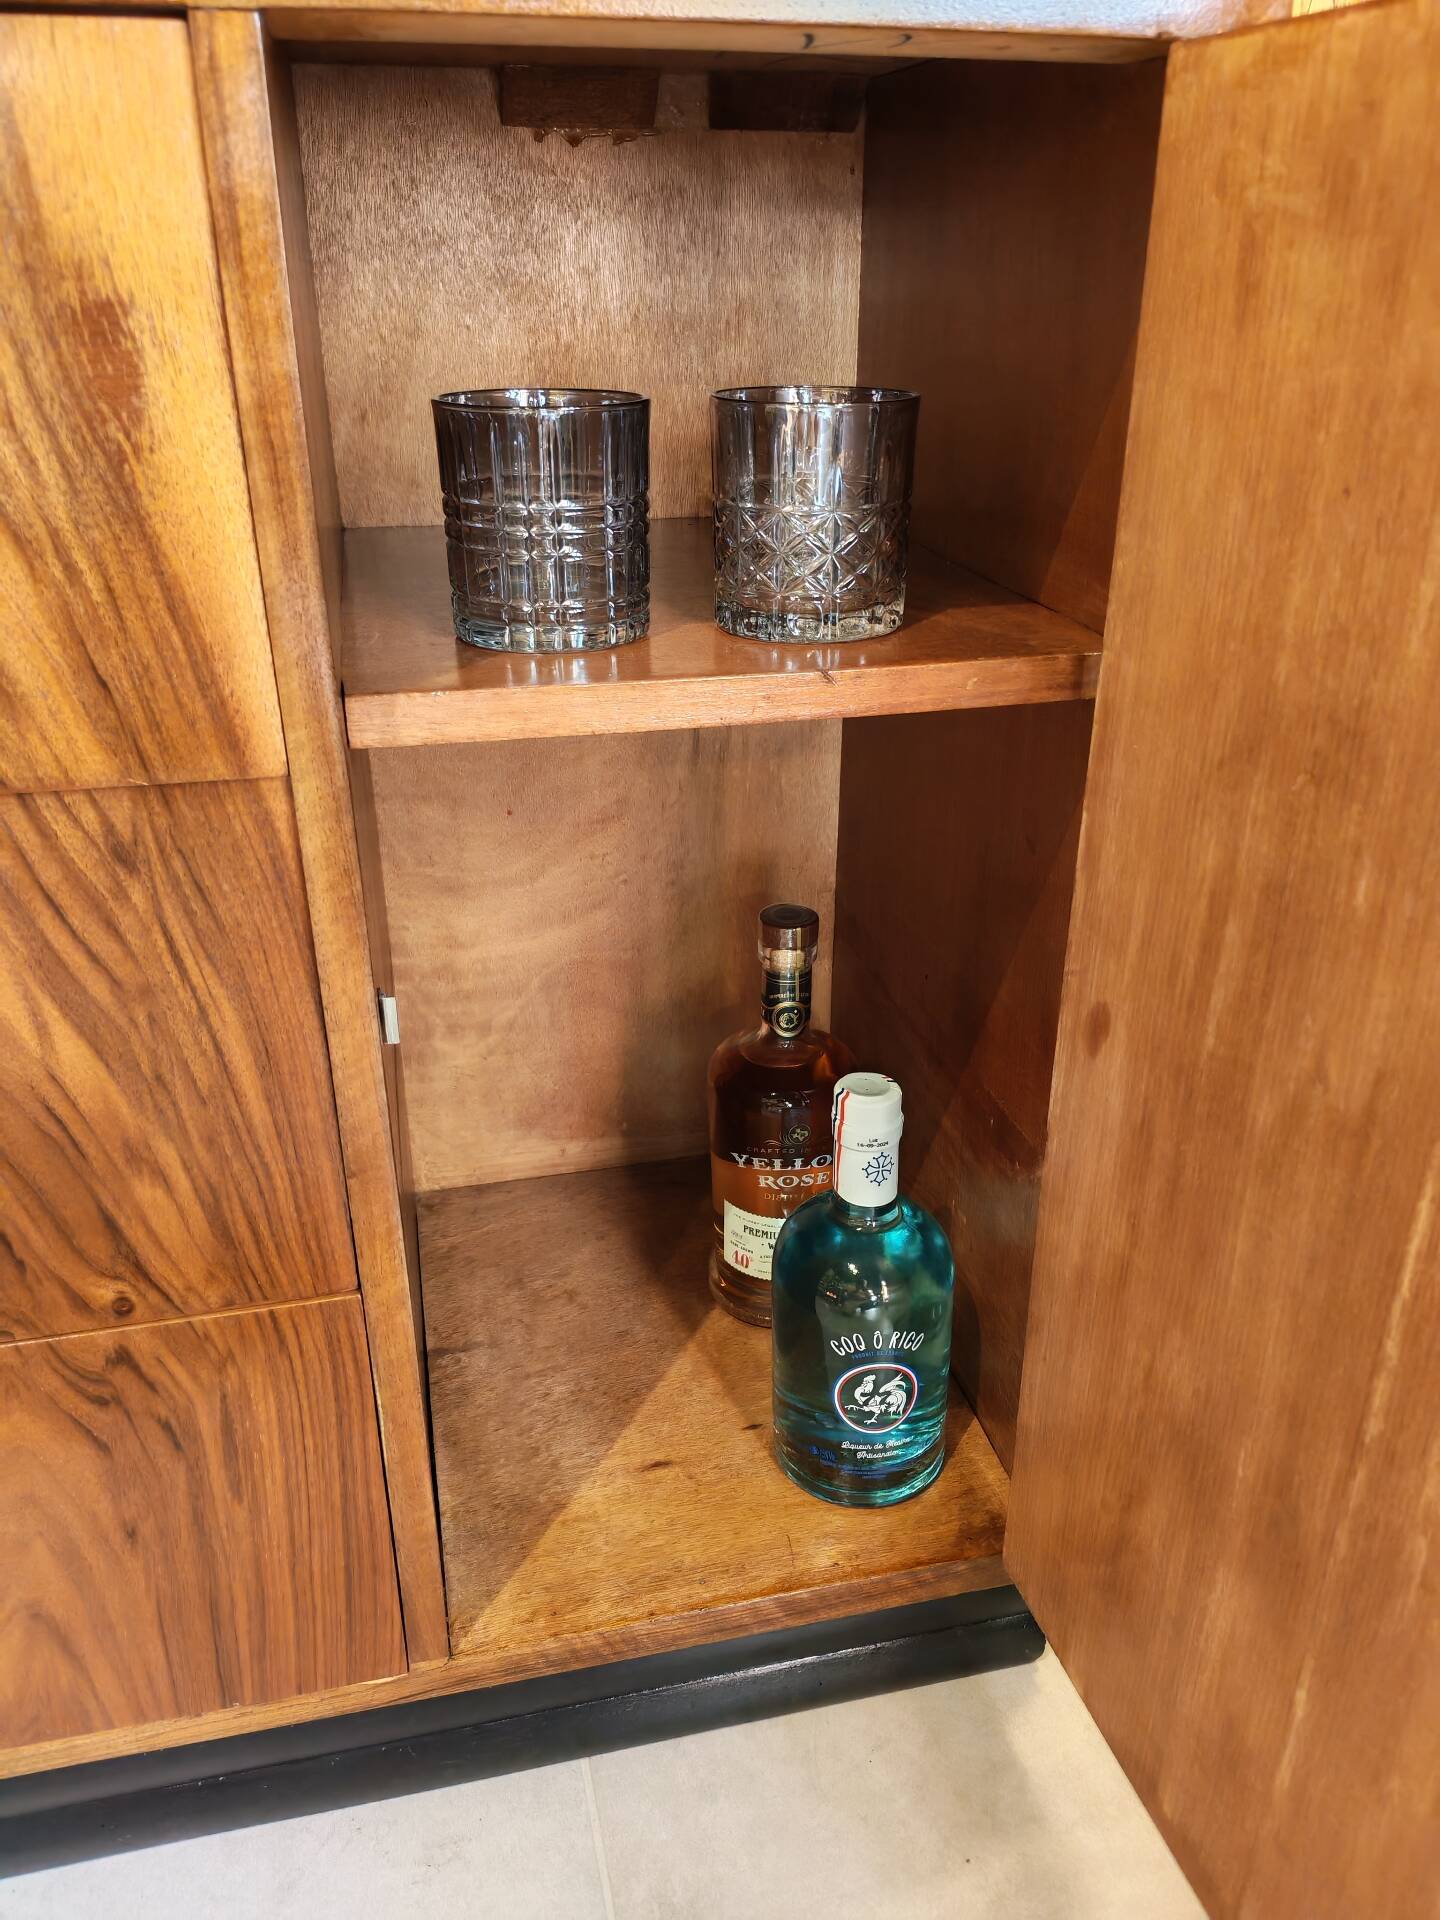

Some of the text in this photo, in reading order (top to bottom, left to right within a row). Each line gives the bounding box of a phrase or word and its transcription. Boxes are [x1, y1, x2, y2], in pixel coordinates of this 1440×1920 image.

[746, 1146, 796, 1154] CRAFTED
[730, 1152, 833, 1171] YELLO
[757, 1172, 830, 1189] ROSE
[830, 1330, 925, 1356] COQ Ô RICO
[841, 1440, 873, 1451] Liqueur
